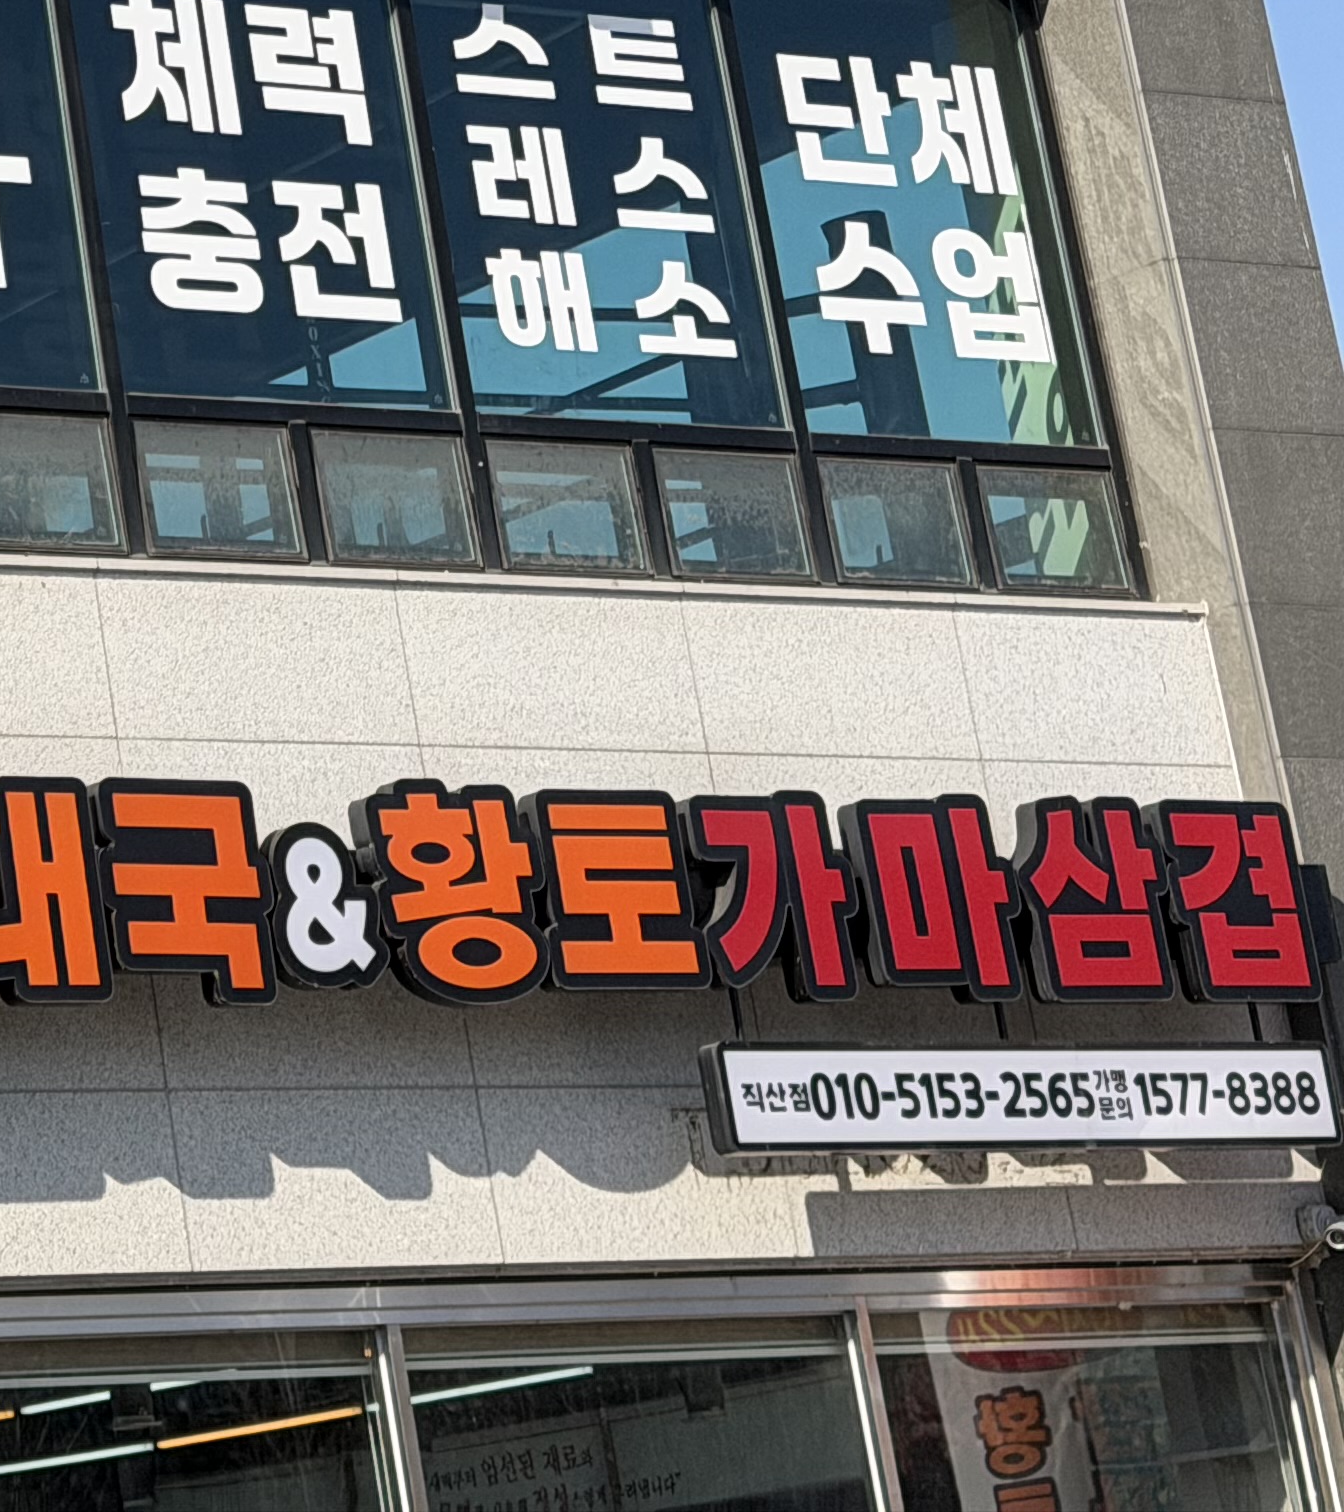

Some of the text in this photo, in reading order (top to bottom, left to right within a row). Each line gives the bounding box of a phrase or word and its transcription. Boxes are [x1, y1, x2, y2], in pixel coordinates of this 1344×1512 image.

[776, 53, 1018, 196] 단체
[137, 167, 403, 323] 충전
[817, 221, 1052, 363] 수업
[810, 1071, 1096, 1122] 010-5153-2565
[1133, 1070, 1321, 1117] 1577-8388
